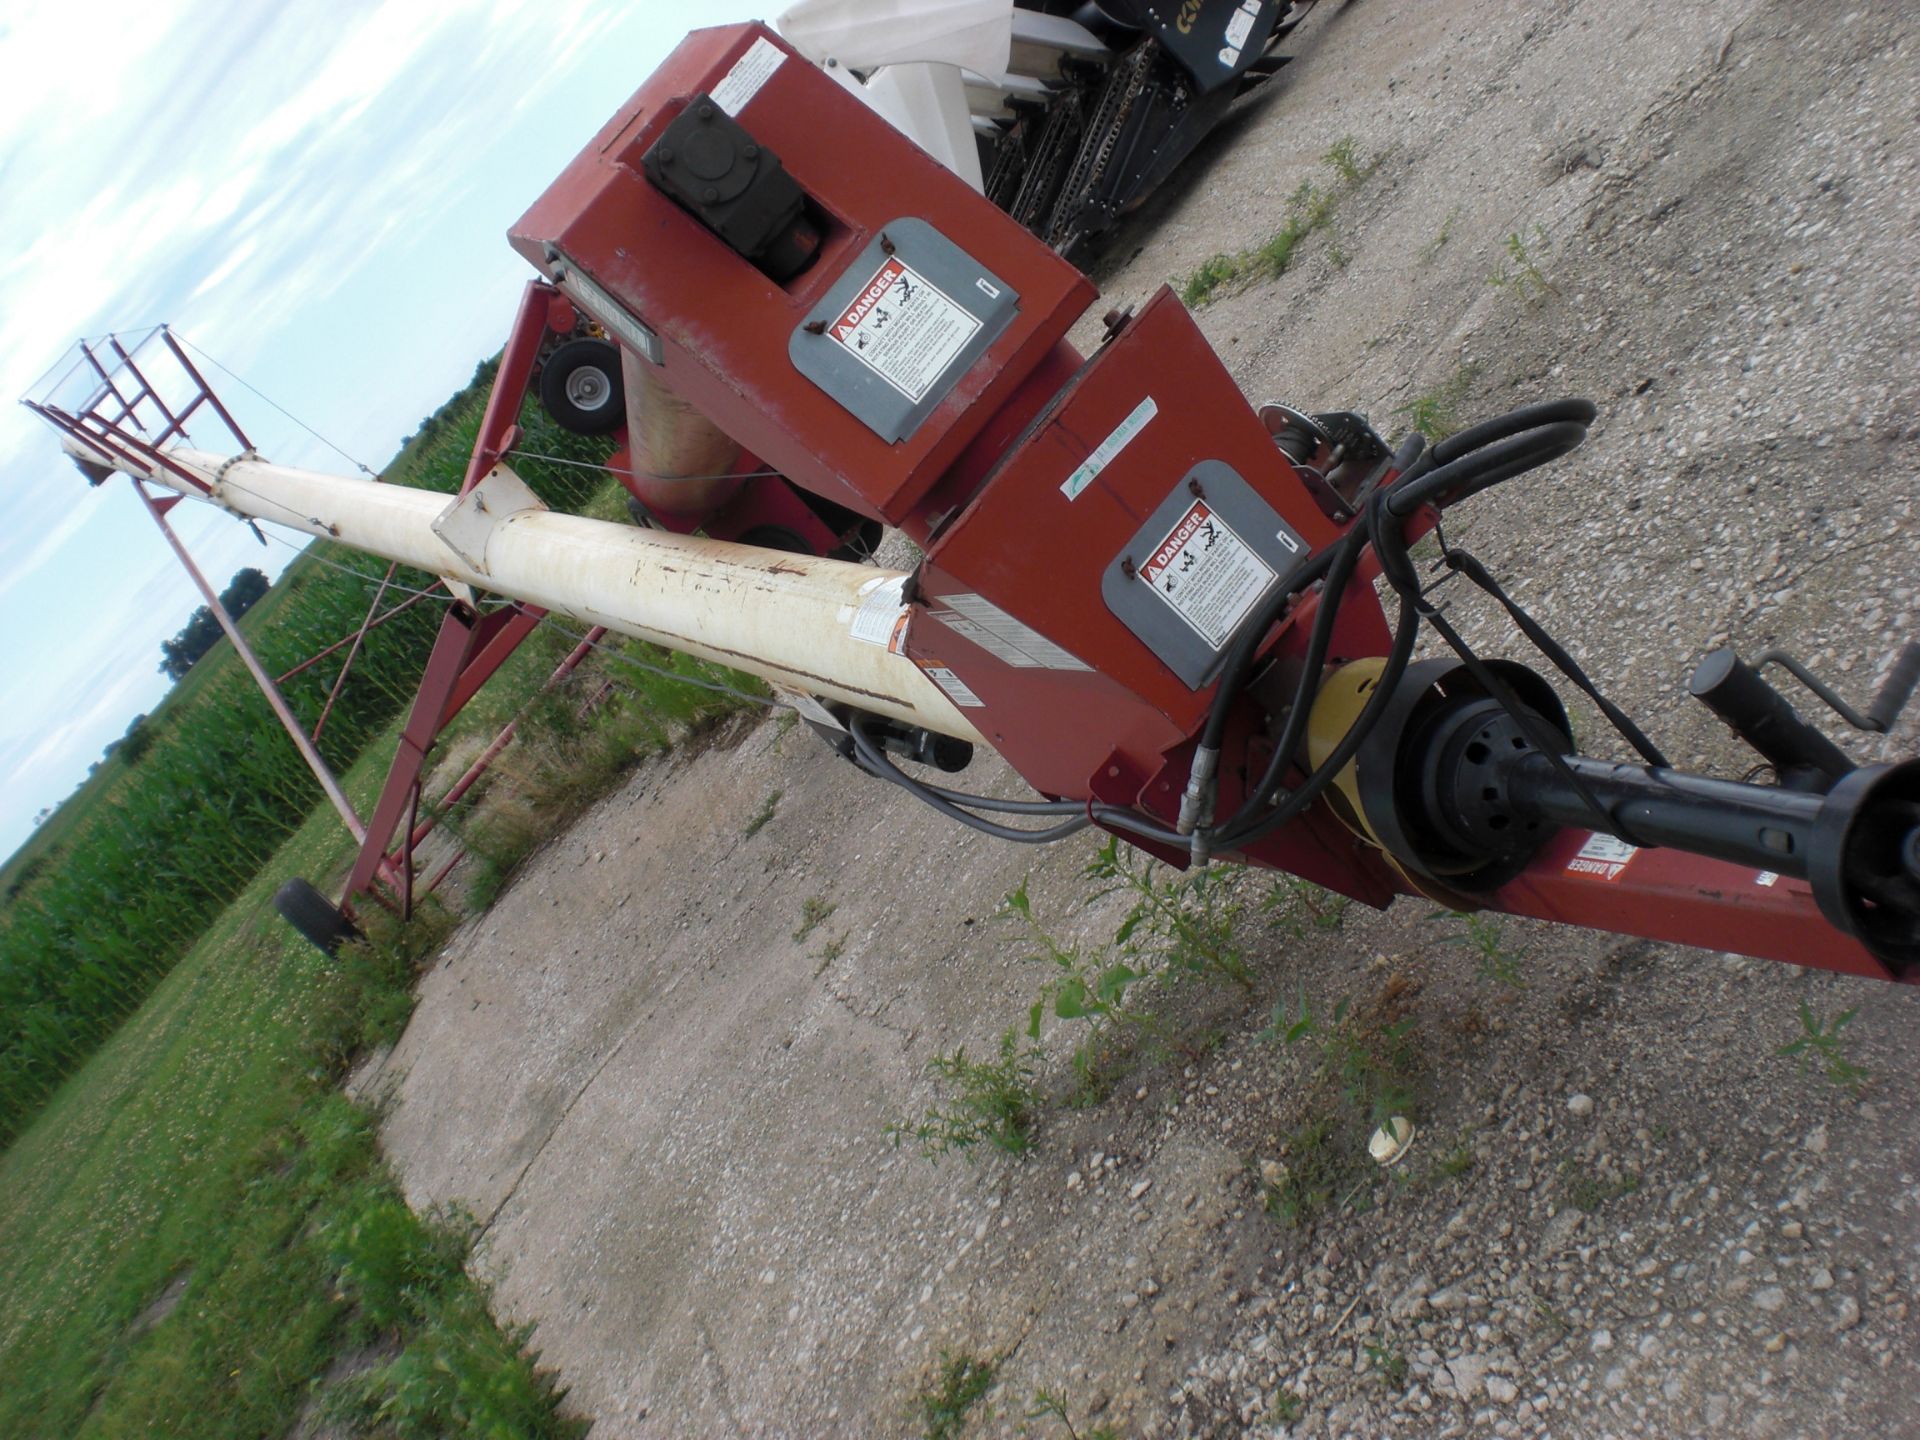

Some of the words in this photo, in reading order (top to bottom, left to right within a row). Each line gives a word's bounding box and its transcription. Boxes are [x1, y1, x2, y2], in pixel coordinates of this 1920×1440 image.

[846, 268, 897, 325] DANGER
[867, 336, 886, 357] CONTACT
[884, 325, 895, 337] WITH
[893, 310, 908, 327] MOVING
[906, 296, 920, 311] PARTS
[870, 341, 889, 362] ROTATING
[1156, 510, 1203, 566] DANGER
[1174, 580, 1191, 600] CONTACT
[1190, 570, 1200, 582] WITH
[1198, 555, 1213, 572] MOVING
[1211, 542, 1224, 556] PARTS
[1177, 586, 1194, 606] ROTATING
[1567, 858, 1608, 875] DANGER
